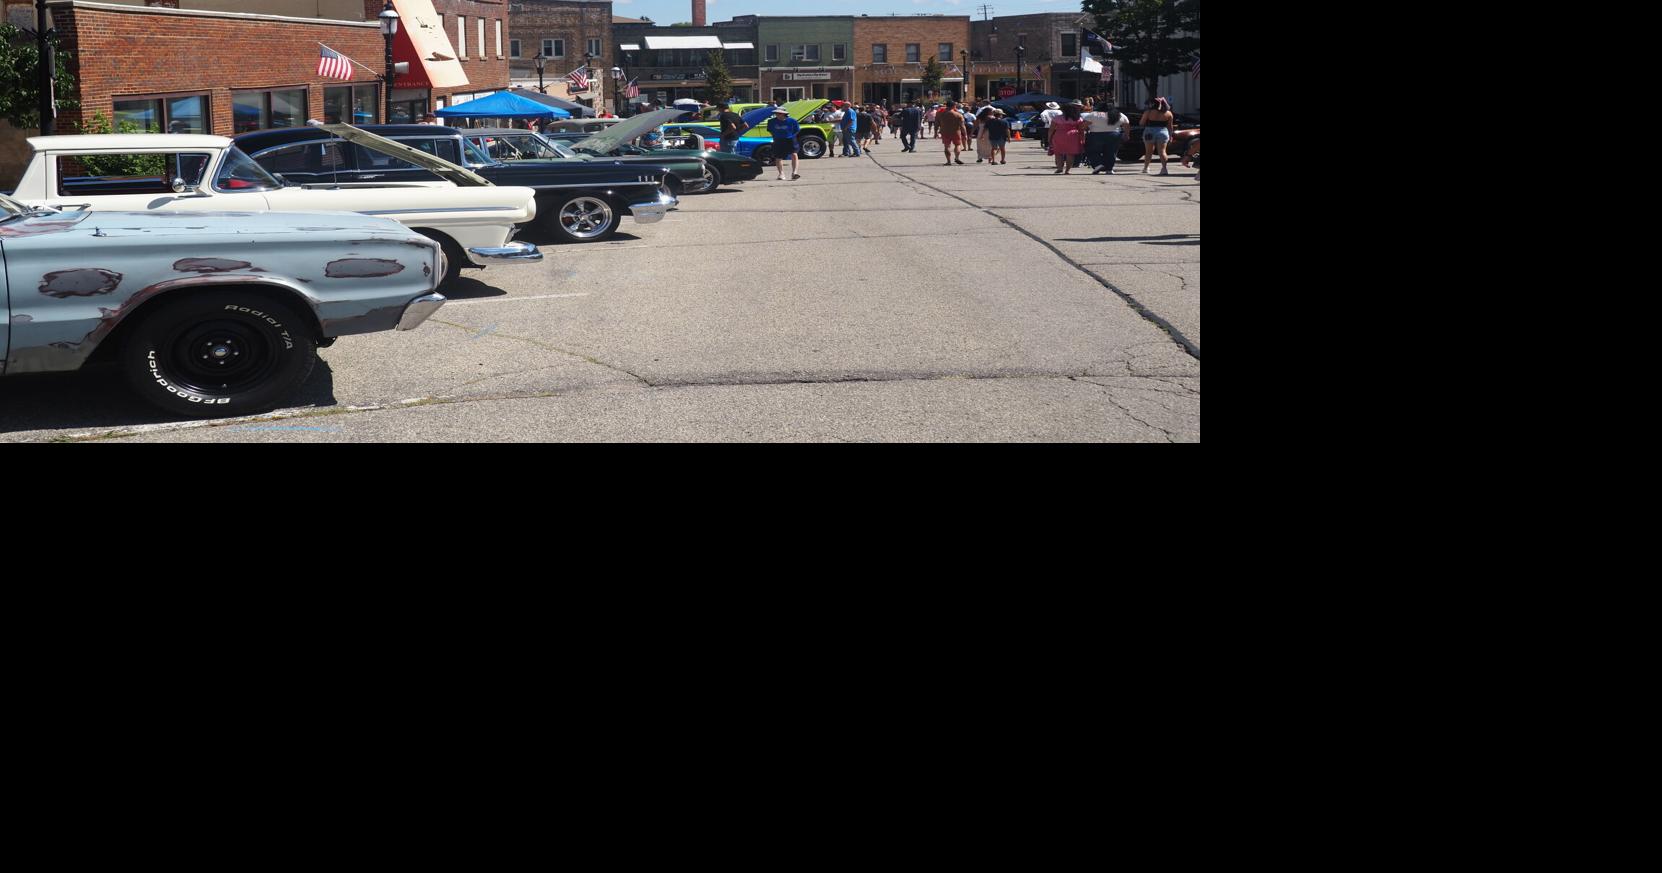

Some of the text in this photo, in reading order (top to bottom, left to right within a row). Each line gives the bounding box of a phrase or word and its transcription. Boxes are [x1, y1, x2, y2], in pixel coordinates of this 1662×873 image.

[224, 304, 293, 350] Radial T/A
[147, 350, 231, 404] BFGoodrich
